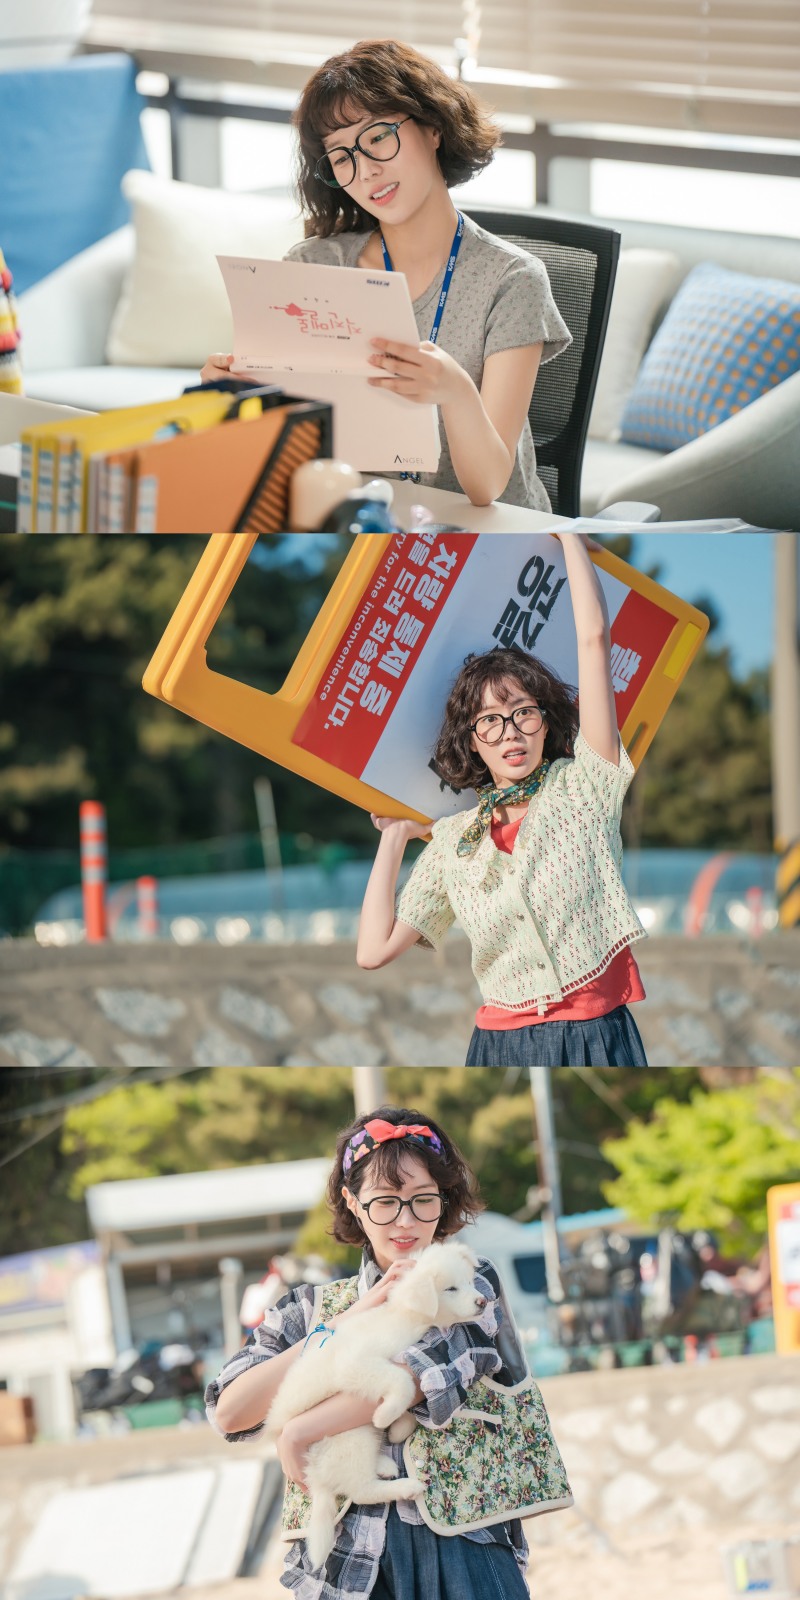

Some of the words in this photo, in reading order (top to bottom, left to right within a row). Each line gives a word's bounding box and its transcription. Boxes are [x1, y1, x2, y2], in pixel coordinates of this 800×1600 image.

[297, 311, 362, 335] 직진멜로
[393, 454, 425, 465] ANGEL
[395, 533, 407, 549] ry
[384, 551, 400, 574] for
[412, 542, 458, 612] 차량
[371, 575, 387, 599] the
[383, 567, 417, 616] 드려
[319, 601, 375, 701] inconvenience
[378, 611, 426, 679] 통제
[323, 616, 392, 731] 죄송합니다.
[359, 680, 393, 717] 중
